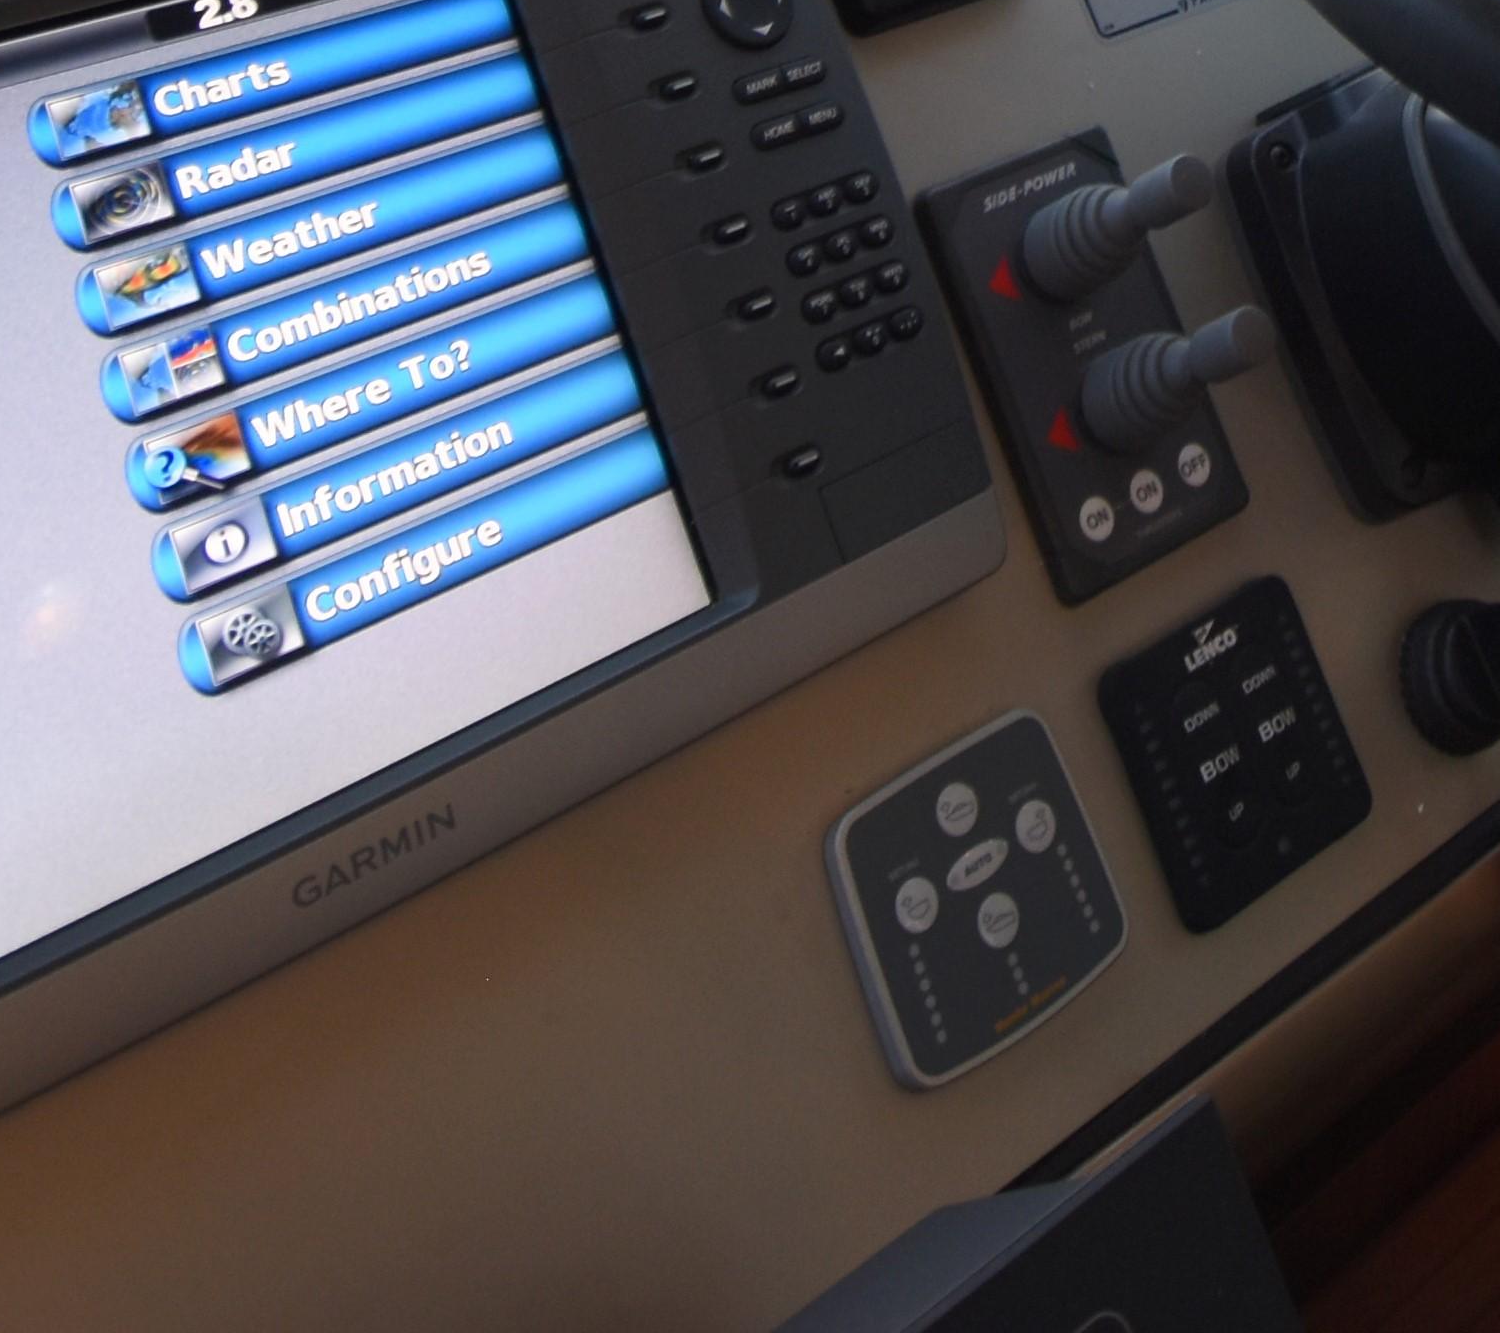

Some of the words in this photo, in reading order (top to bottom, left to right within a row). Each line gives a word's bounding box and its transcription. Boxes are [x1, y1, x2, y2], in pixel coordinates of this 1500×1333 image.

[153, 57, 291, 119] Charts
[746, 76, 778, 95] MARK
[786, 60, 822, 82] SELECT
[763, 120, 796, 141] HOME
[808, 107, 837, 125] MENU
[174, 140, 296, 200] Radar
[983, 162, 1077, 214] SIDE-POWER
[200, 200, 379, 281] Weather
[226, 247, 492, 366] Combinations
[251, 377, 391, 449] Where
[398, 340, 471, 395] To?
[276, 417, 513, 541] Information
[1181, 452, 1207, 479] OFF
[1136, 480, 1157, 503] ON
[1086, 509, 1109, 532] ON
[304, 515, 504, 625] Configure
[1184, 628, 1237, 673] LENCO
[1242, 664, 1276, 695] DOWN
[1184, 701, 1220, 734] DOWN
[1258, 706, 1296, 743] BOW
[1200, 744, 1240, 784] BOW
[1285, 761, 1301, 780] UP
[1228, 801, 1245, 822] UP
[291, 803, 458, 908] GARMIN
